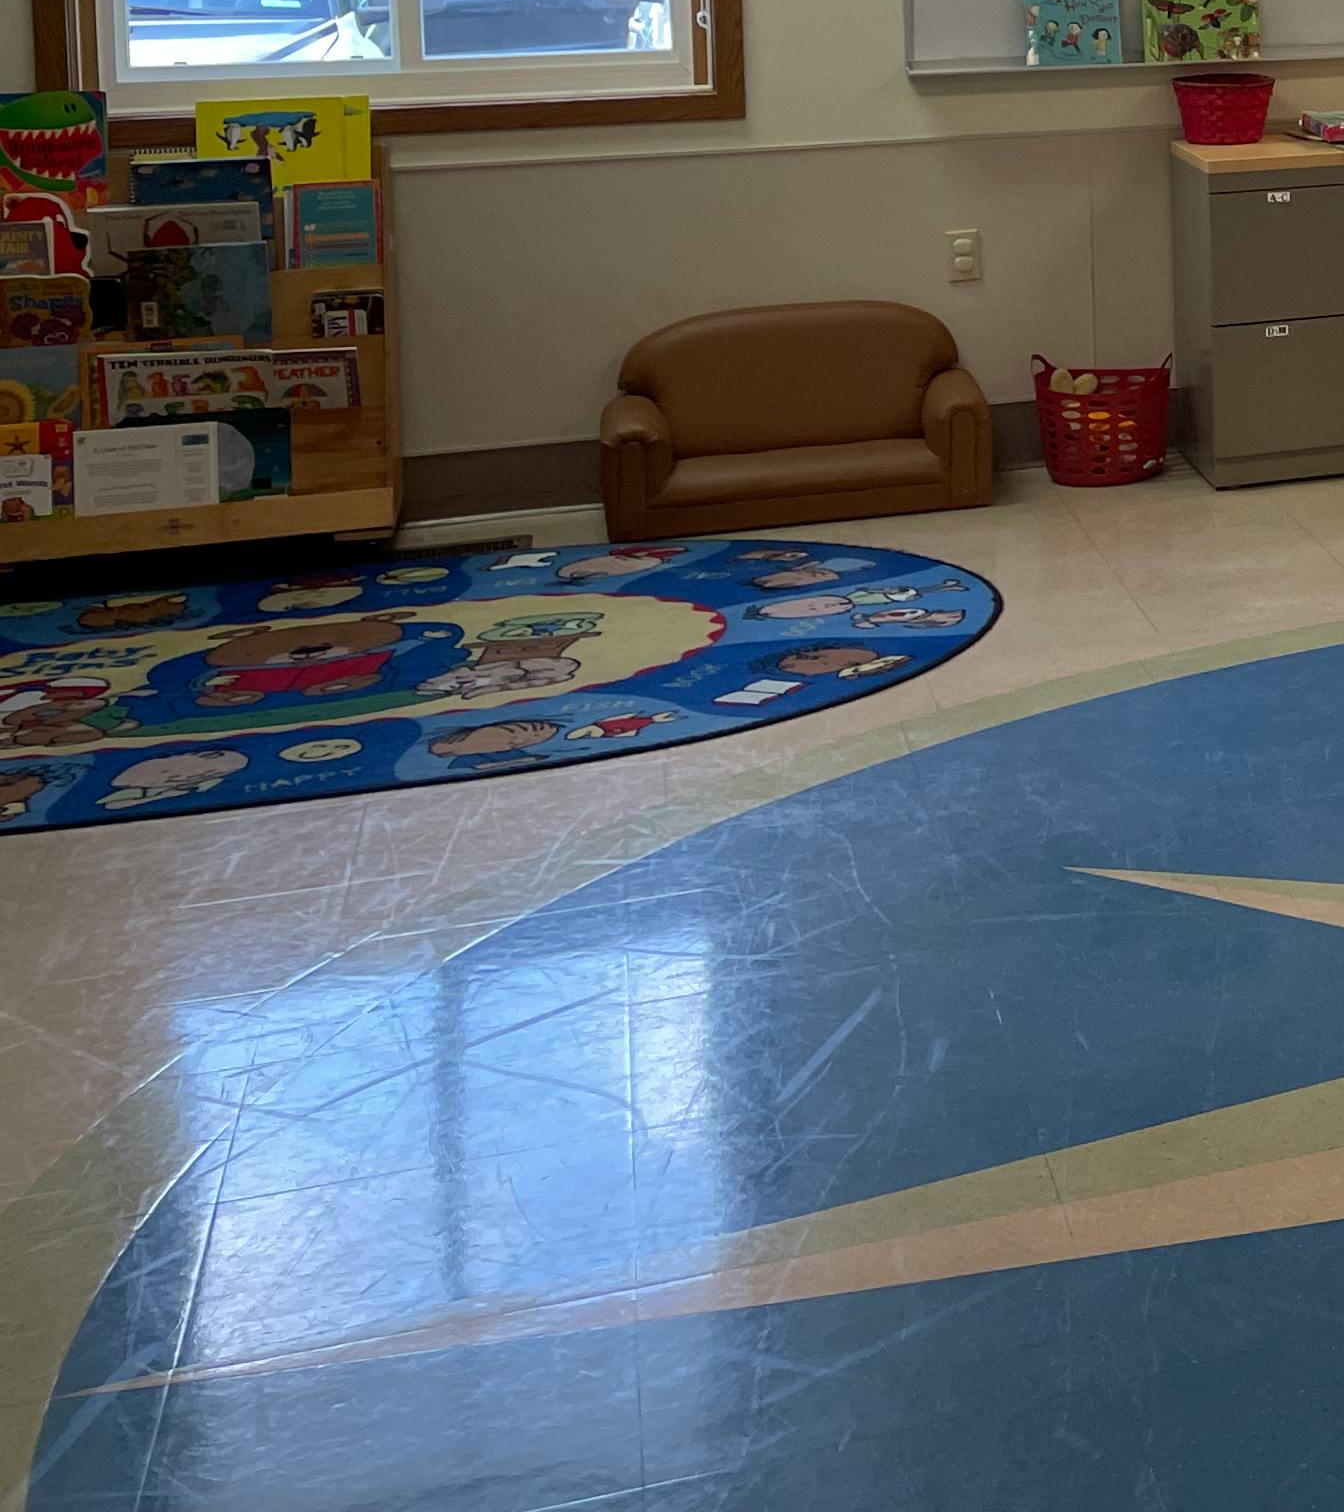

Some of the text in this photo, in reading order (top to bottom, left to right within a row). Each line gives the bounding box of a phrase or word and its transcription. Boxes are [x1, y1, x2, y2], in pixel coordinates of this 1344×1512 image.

[109, 360, 138, 370] TEN
[143, 357, 199, 368] TERRIBLE
[25, 645, 156, 664] Baby
[560, 699, 636, 713] FISH
[243, 765, 363, 794] HAPPY
